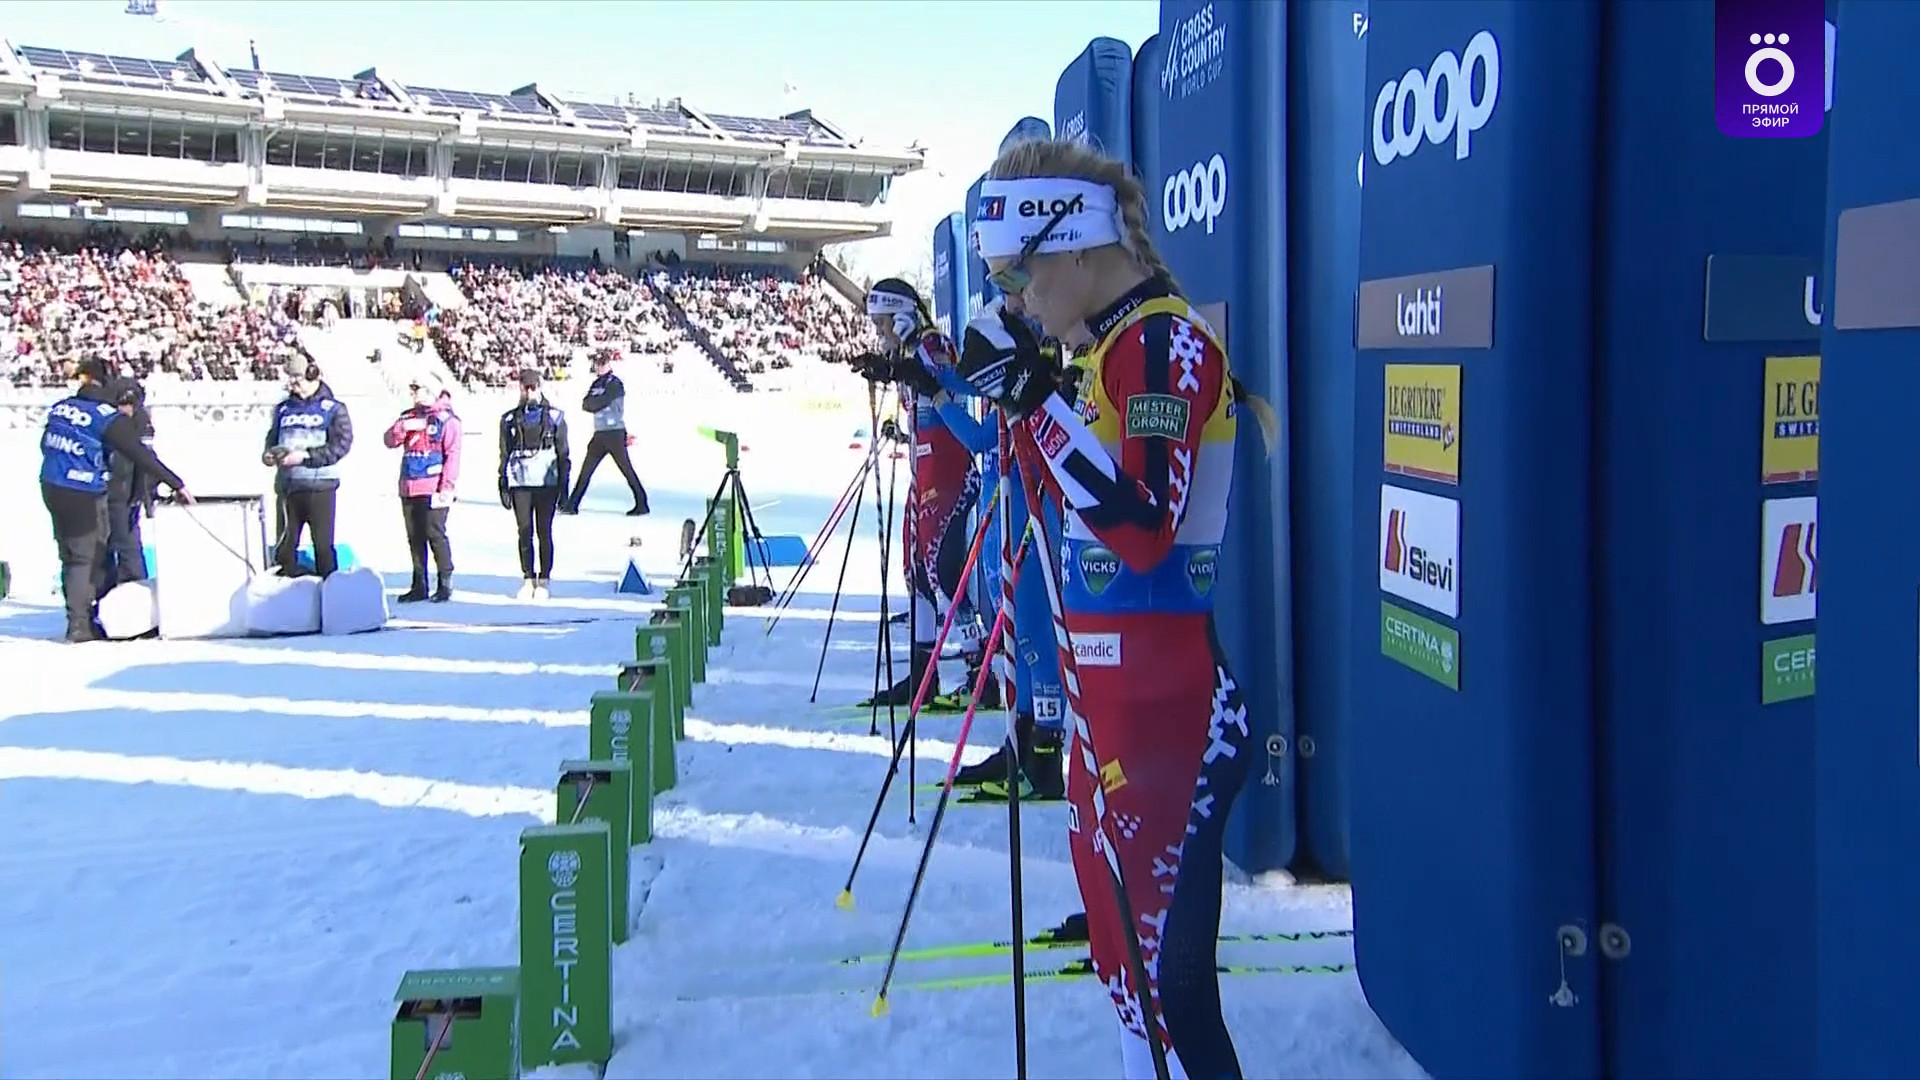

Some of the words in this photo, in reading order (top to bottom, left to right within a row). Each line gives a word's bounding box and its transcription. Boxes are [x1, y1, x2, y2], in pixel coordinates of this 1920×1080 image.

[1181, 2, 1214, 45] CROSS
[1181, 24, 1227, 78] COUNTRY
[1181, 76, 1206, 99] WORLD
[1207, 59, 1223, 83] CUP
[1372, 29, 1500, 165] coop
[1163, 153, 1227, 235] coop
[1099, 301, 1131, 333] CRAFT
[1396, 285, 1442, 336] Lahti
[1133, 400, 1181, 416] MESTER
[1389, 385, 1400, 416] LE
[1775, 382, 1796, 417] LE
[1081, 561, 1117, 573] VICKS
[1409, 546, 1453, 592] Sievi
[962, 625, 977, 640] 10
[1385, 616, 1440, 655] CERTINA
[1037, 701, 1057, 717] 15
[551, 891, 581, 1050] CERTINA
